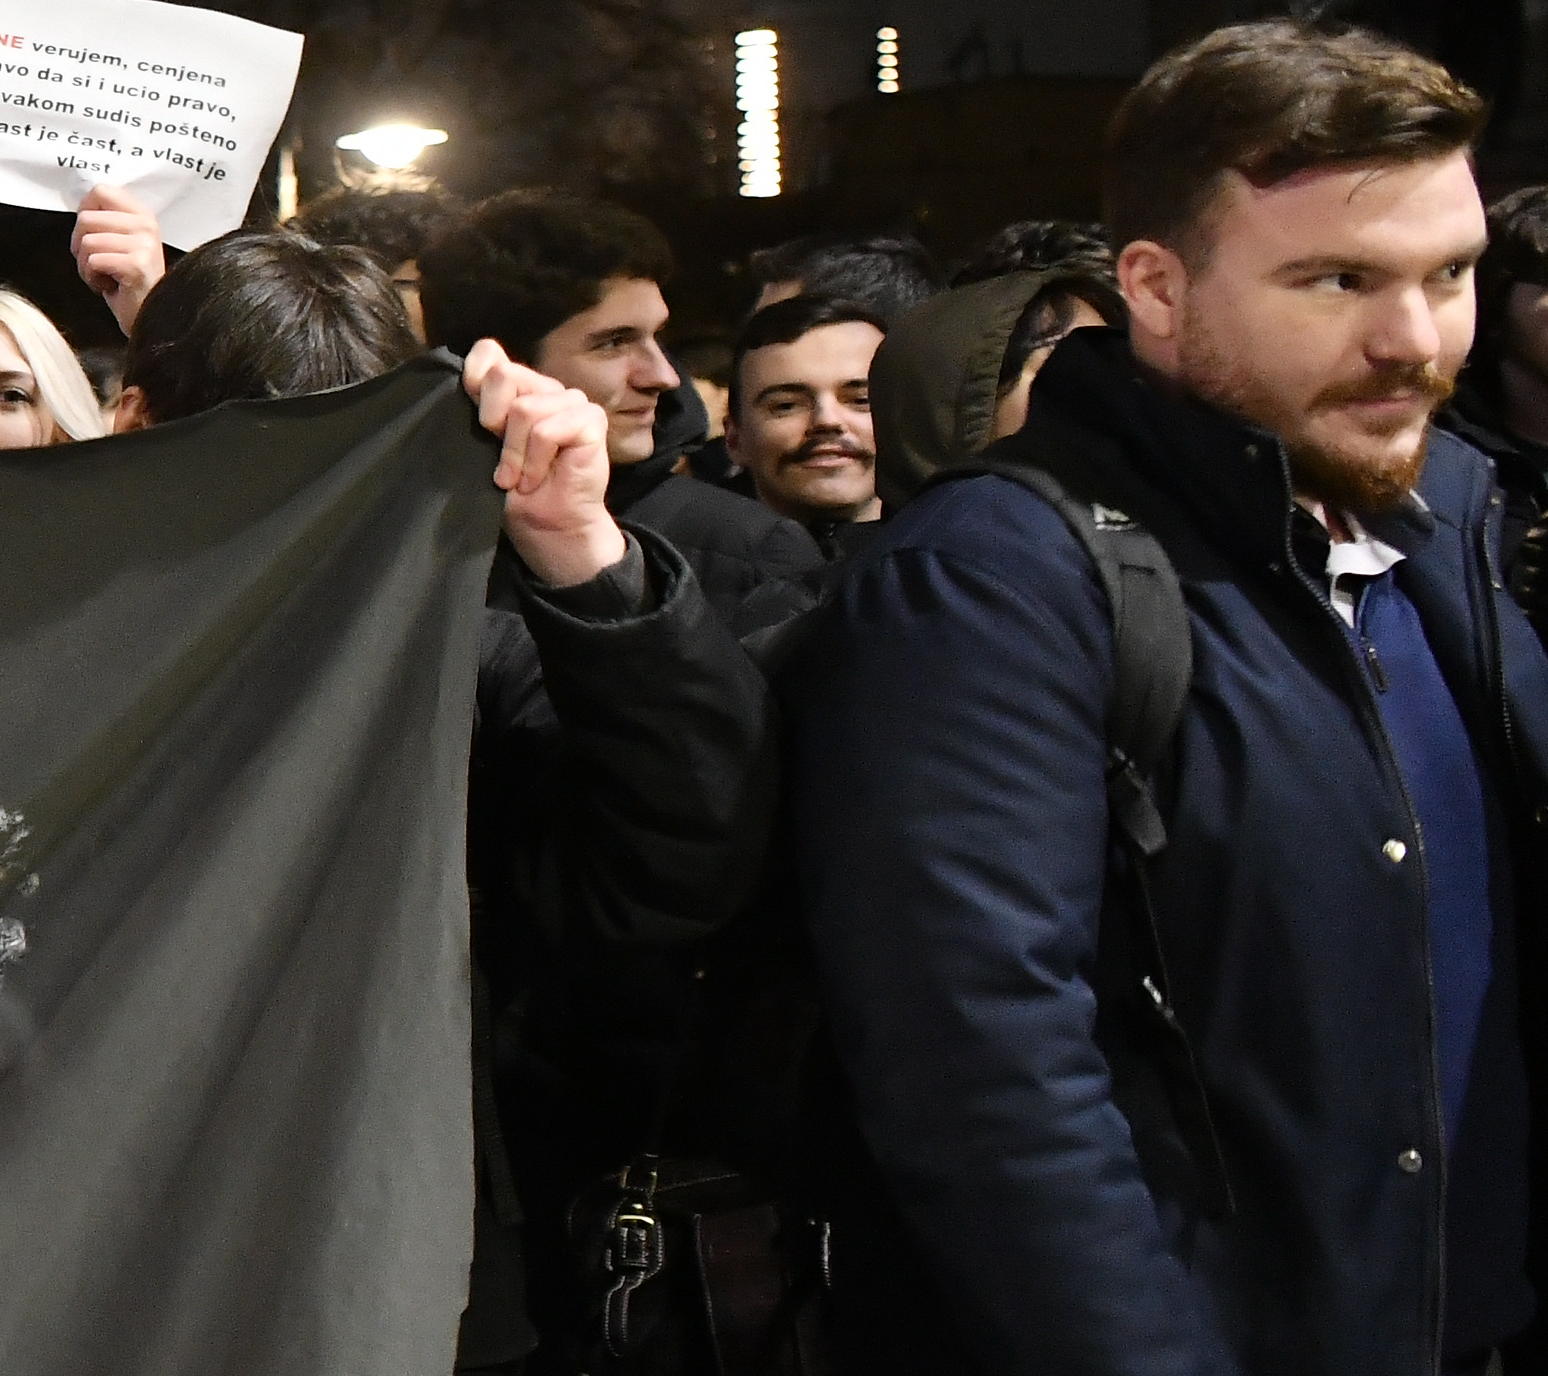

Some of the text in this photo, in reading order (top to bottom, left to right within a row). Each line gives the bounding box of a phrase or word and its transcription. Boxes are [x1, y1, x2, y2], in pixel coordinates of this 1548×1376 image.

[32, 42, 128, 70] verujem,
[137, 61, 226, 89] cenjena
[37, 67, 63, 83] da
[71, 75, 91, 88] si
[98, 77, 105, 91] i
[113, 83, 160, 101] ucio
[167, 94, 236, 123] pravo,
[82, 106, 142, 128] sudis
[149, 115, 237, 152] pošteno
[36, 125, 59, 142] je
[67, 130, 122, 156] čast,
[130, 146, 144, 157] a
[153, 147, 205, 173] vlast
[203, 162, 226, 181] je
[56, 156, 111, 174] vlast
